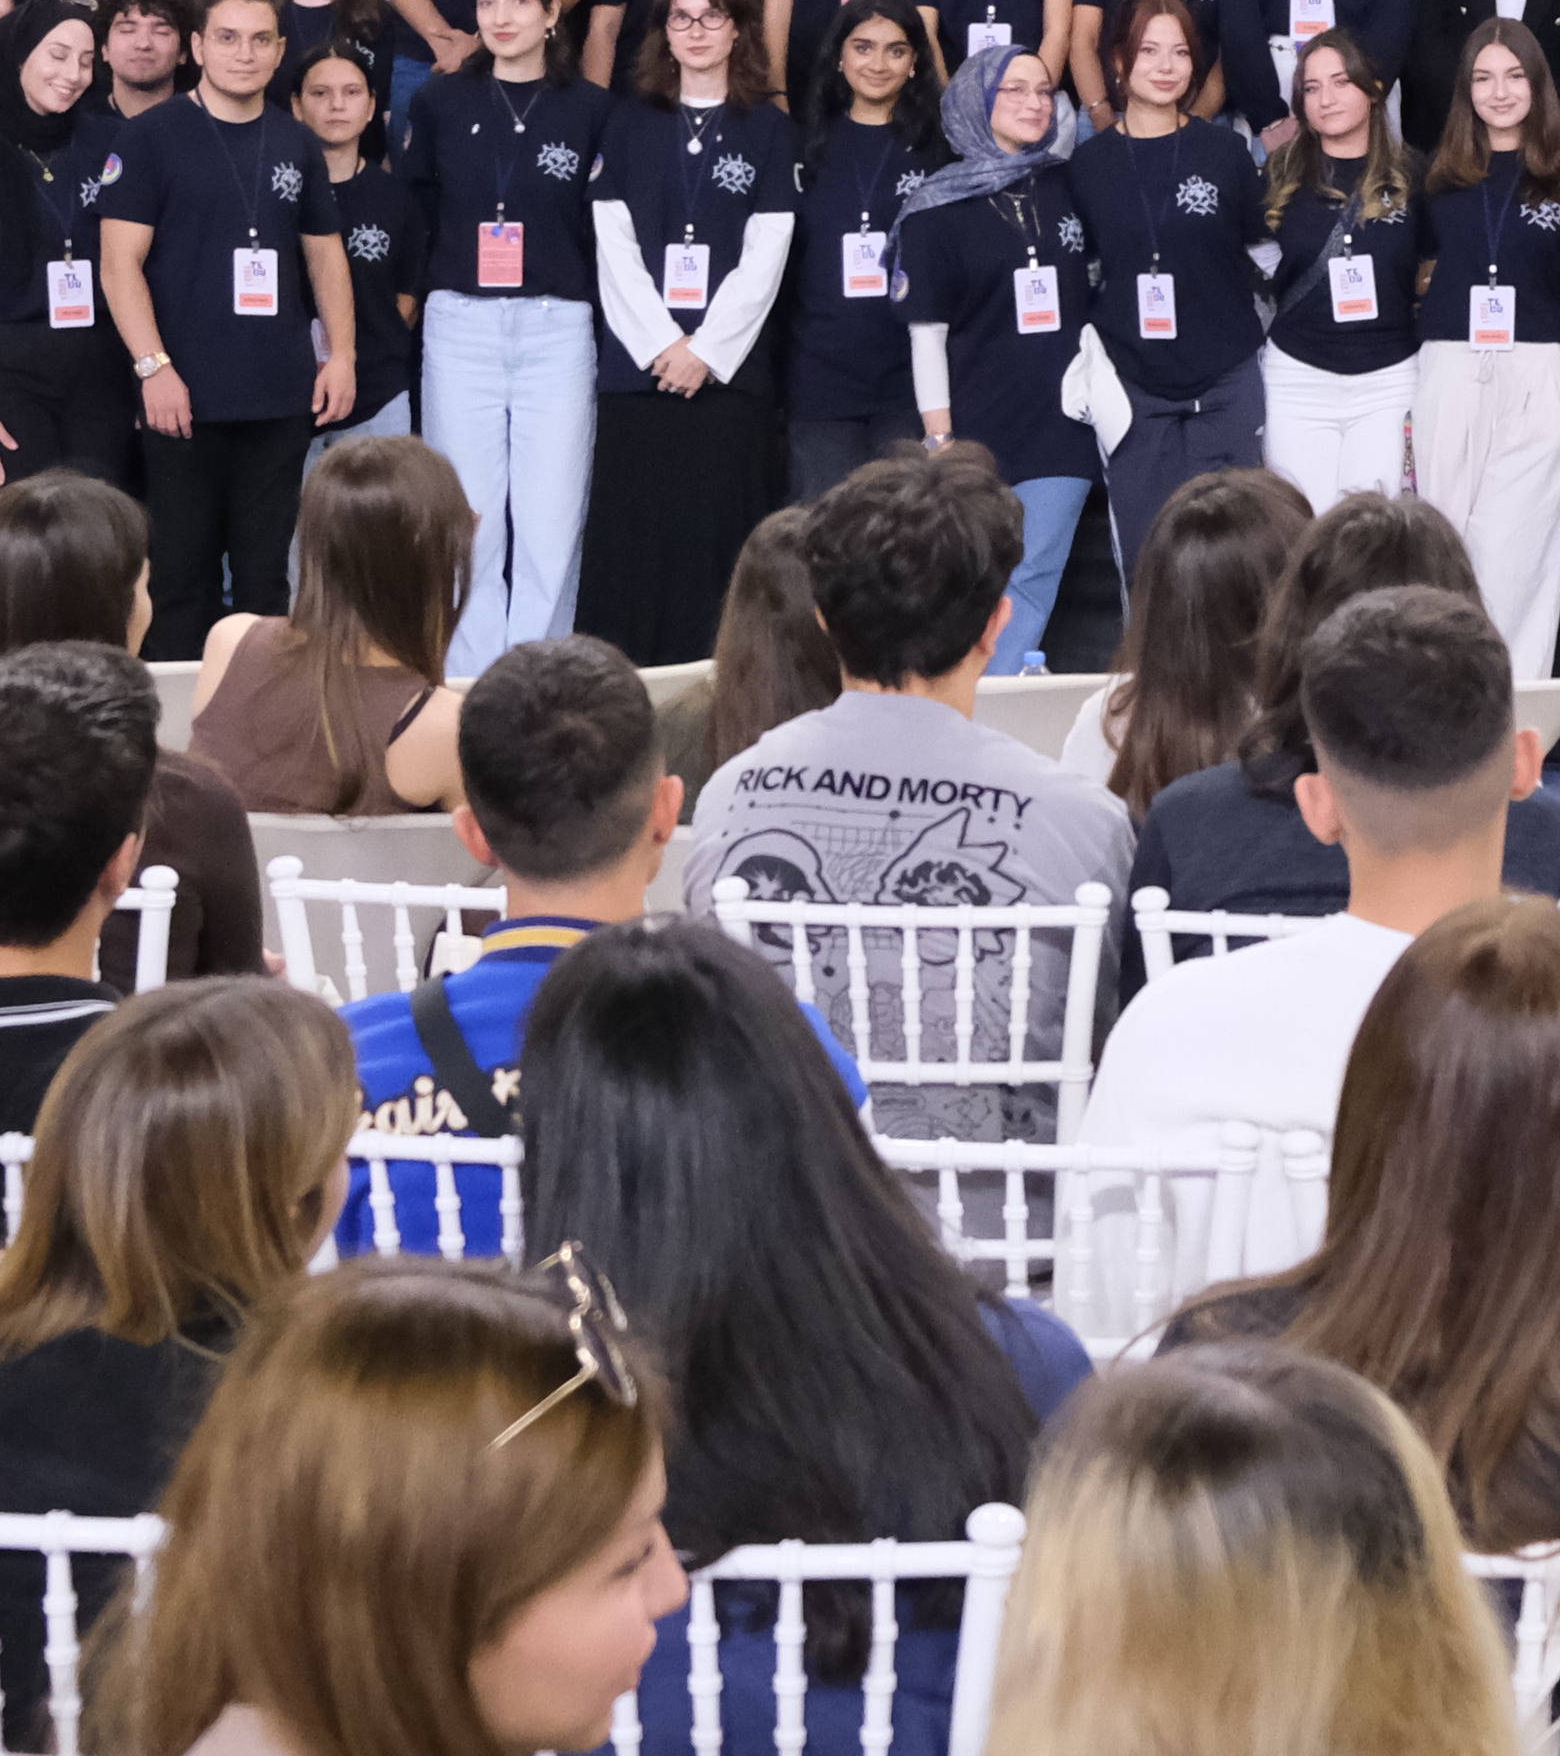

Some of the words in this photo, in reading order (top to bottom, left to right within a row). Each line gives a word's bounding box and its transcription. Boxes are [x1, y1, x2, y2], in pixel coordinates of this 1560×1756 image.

[734, 766, 810, 794] RICK
[812, 770, 891, 801] AND
[896, 778, 1036, 818] MORTY
